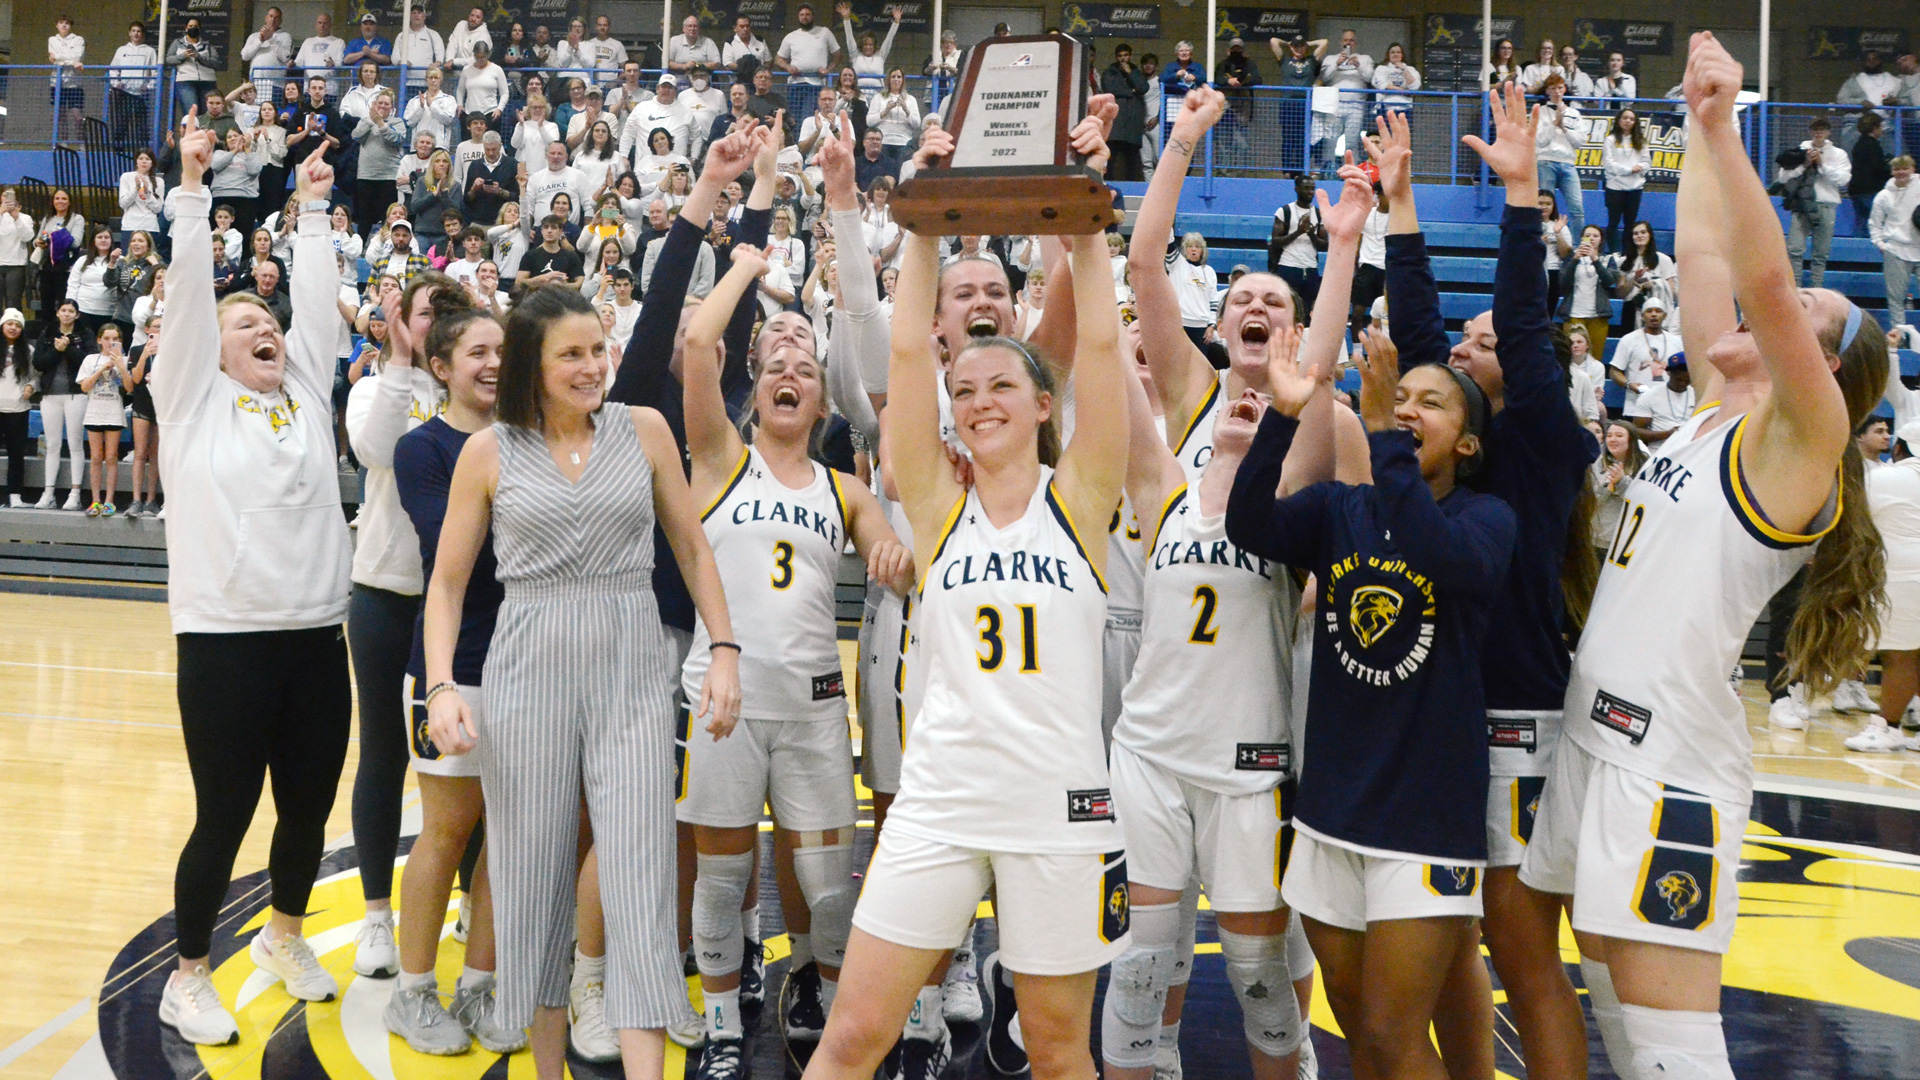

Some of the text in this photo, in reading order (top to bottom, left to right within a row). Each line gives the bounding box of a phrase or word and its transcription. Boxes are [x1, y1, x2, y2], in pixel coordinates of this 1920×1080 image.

[738, 2, 775, 11] CLARKE
[1111, 9, 1149, 20] CLARKE
[1260, 13, 1298, 23] CLARKE
[1101, 22, 1132, 30] Women's
[1625, 25, 1664, 36] CLARKE
[981, 90, 1049, 100] TOURNAMENT
[985, 101, 1040, 111] CHAMPION
[992, 148, 1017, 157] 2022
[538, 182, 567, 193] CLARKE
[732, 500, 838, 552] CLARKE
[1608, 499, 1645, 569] 12
[770, 540, 795, 591] 3
[943, 550, 1074, 593] CLARKE
[1155, 540, 1271, 580] CLARKE
[1368, 556, 1437, 616] UNIVERSTY
[1187, 583, 1221, 646] 2
[974, 604, 1042, 674] 31
[1326, 611, 1435, 687] BE A BETTER HUMAN
